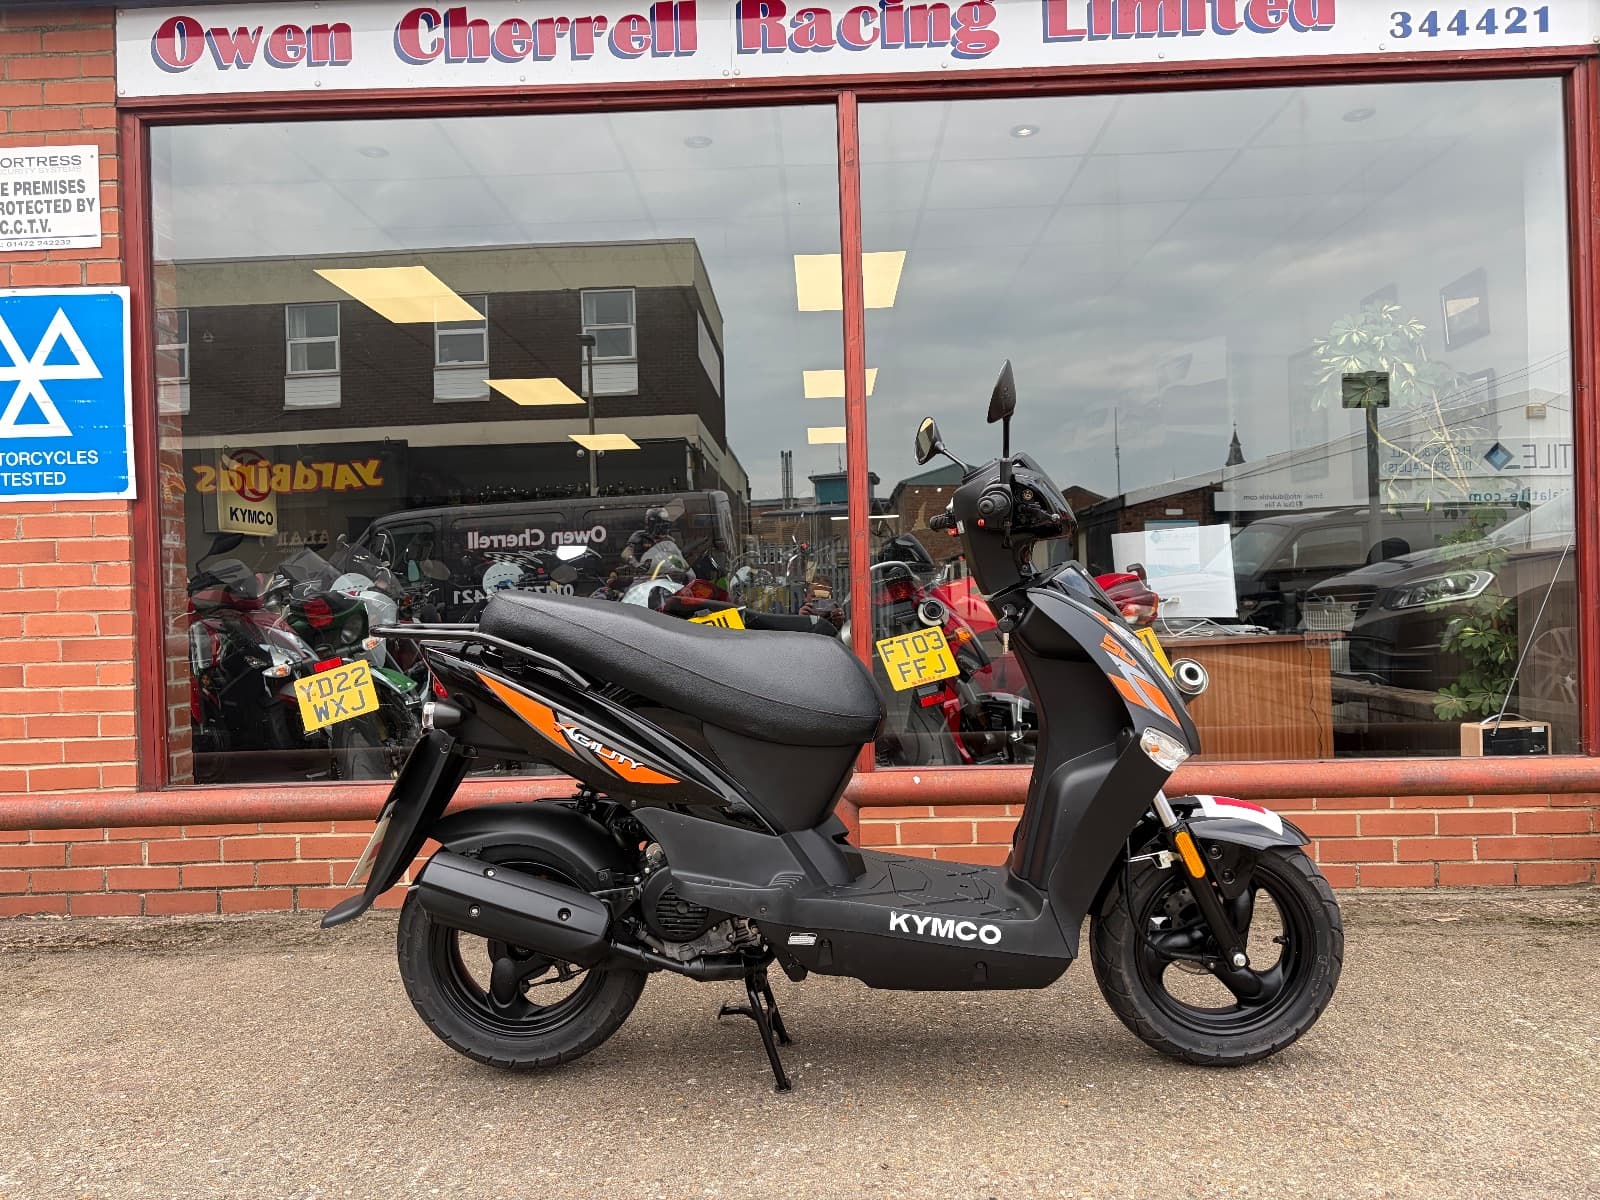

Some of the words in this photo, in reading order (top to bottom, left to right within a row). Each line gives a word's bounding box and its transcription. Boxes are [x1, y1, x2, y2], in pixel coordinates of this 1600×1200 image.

[151, 15, 352, 73] Owen
[393, 0, 698, 65] Cherrell
[736, 0, 1000, 59] Racing
[1042, 0, 1335, 43] Limited
[1390, 6, 1549, 39] 344421
[13, 179, 86, 196] PREMISES
[76, 198, 95, 212] BY
[0, 219, 52, 235] C.C.T.V.
[0, 472, 67, 487] TESTED
[229, 506, 275, 526] KYMCO
[880, 631, 944, 663] FT03
[897, 653, 947, 683] FFJ
[299, 666, 369, 702] YD22
[313, 690, 366, 723] WXJ
[889, 910, 1002, 945] KYMCO
